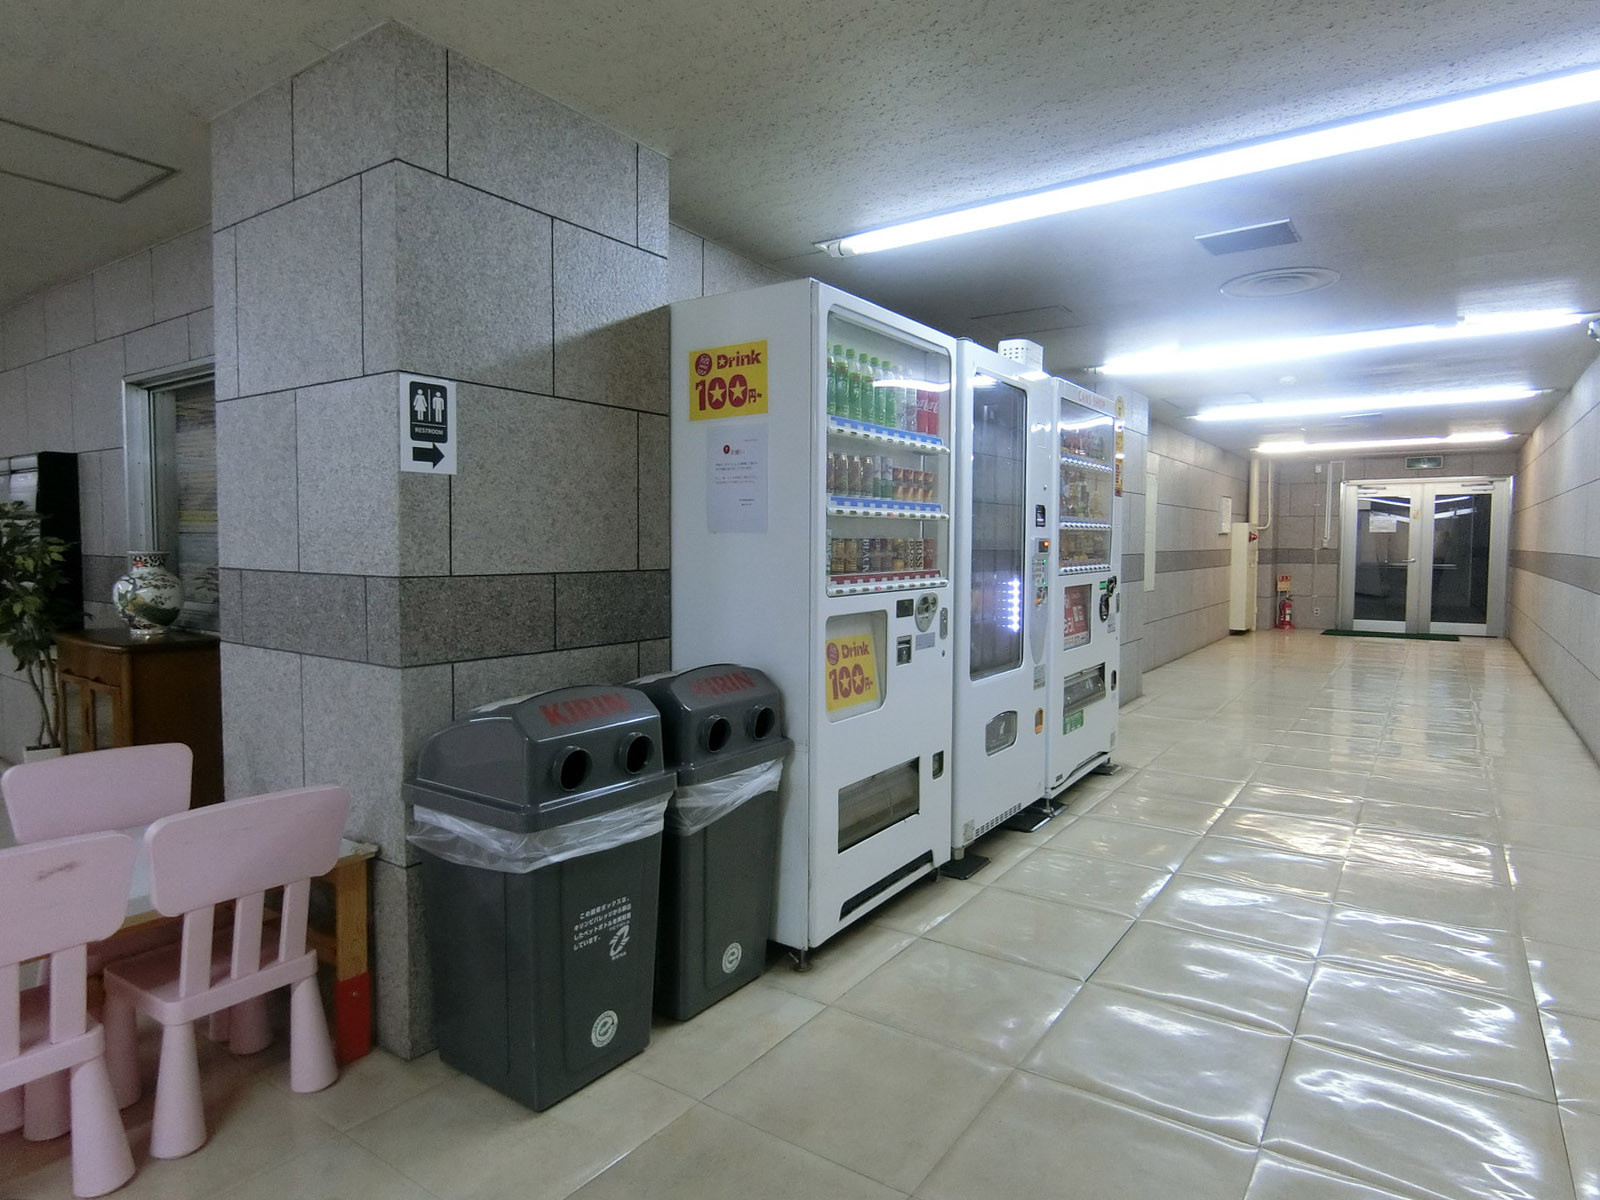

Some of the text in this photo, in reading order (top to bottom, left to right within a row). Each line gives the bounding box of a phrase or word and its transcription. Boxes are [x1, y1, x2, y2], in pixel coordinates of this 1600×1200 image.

[716, 349, 762, 370] Drink
[414, 426, 444, 436] RESTROOM
[915, 540, 924, 568] BOSS
[841, 641, 870, 659] Drink
[689, 671, 756, 696] KIRIN
[538, 693, 632, 727] KIRIN
